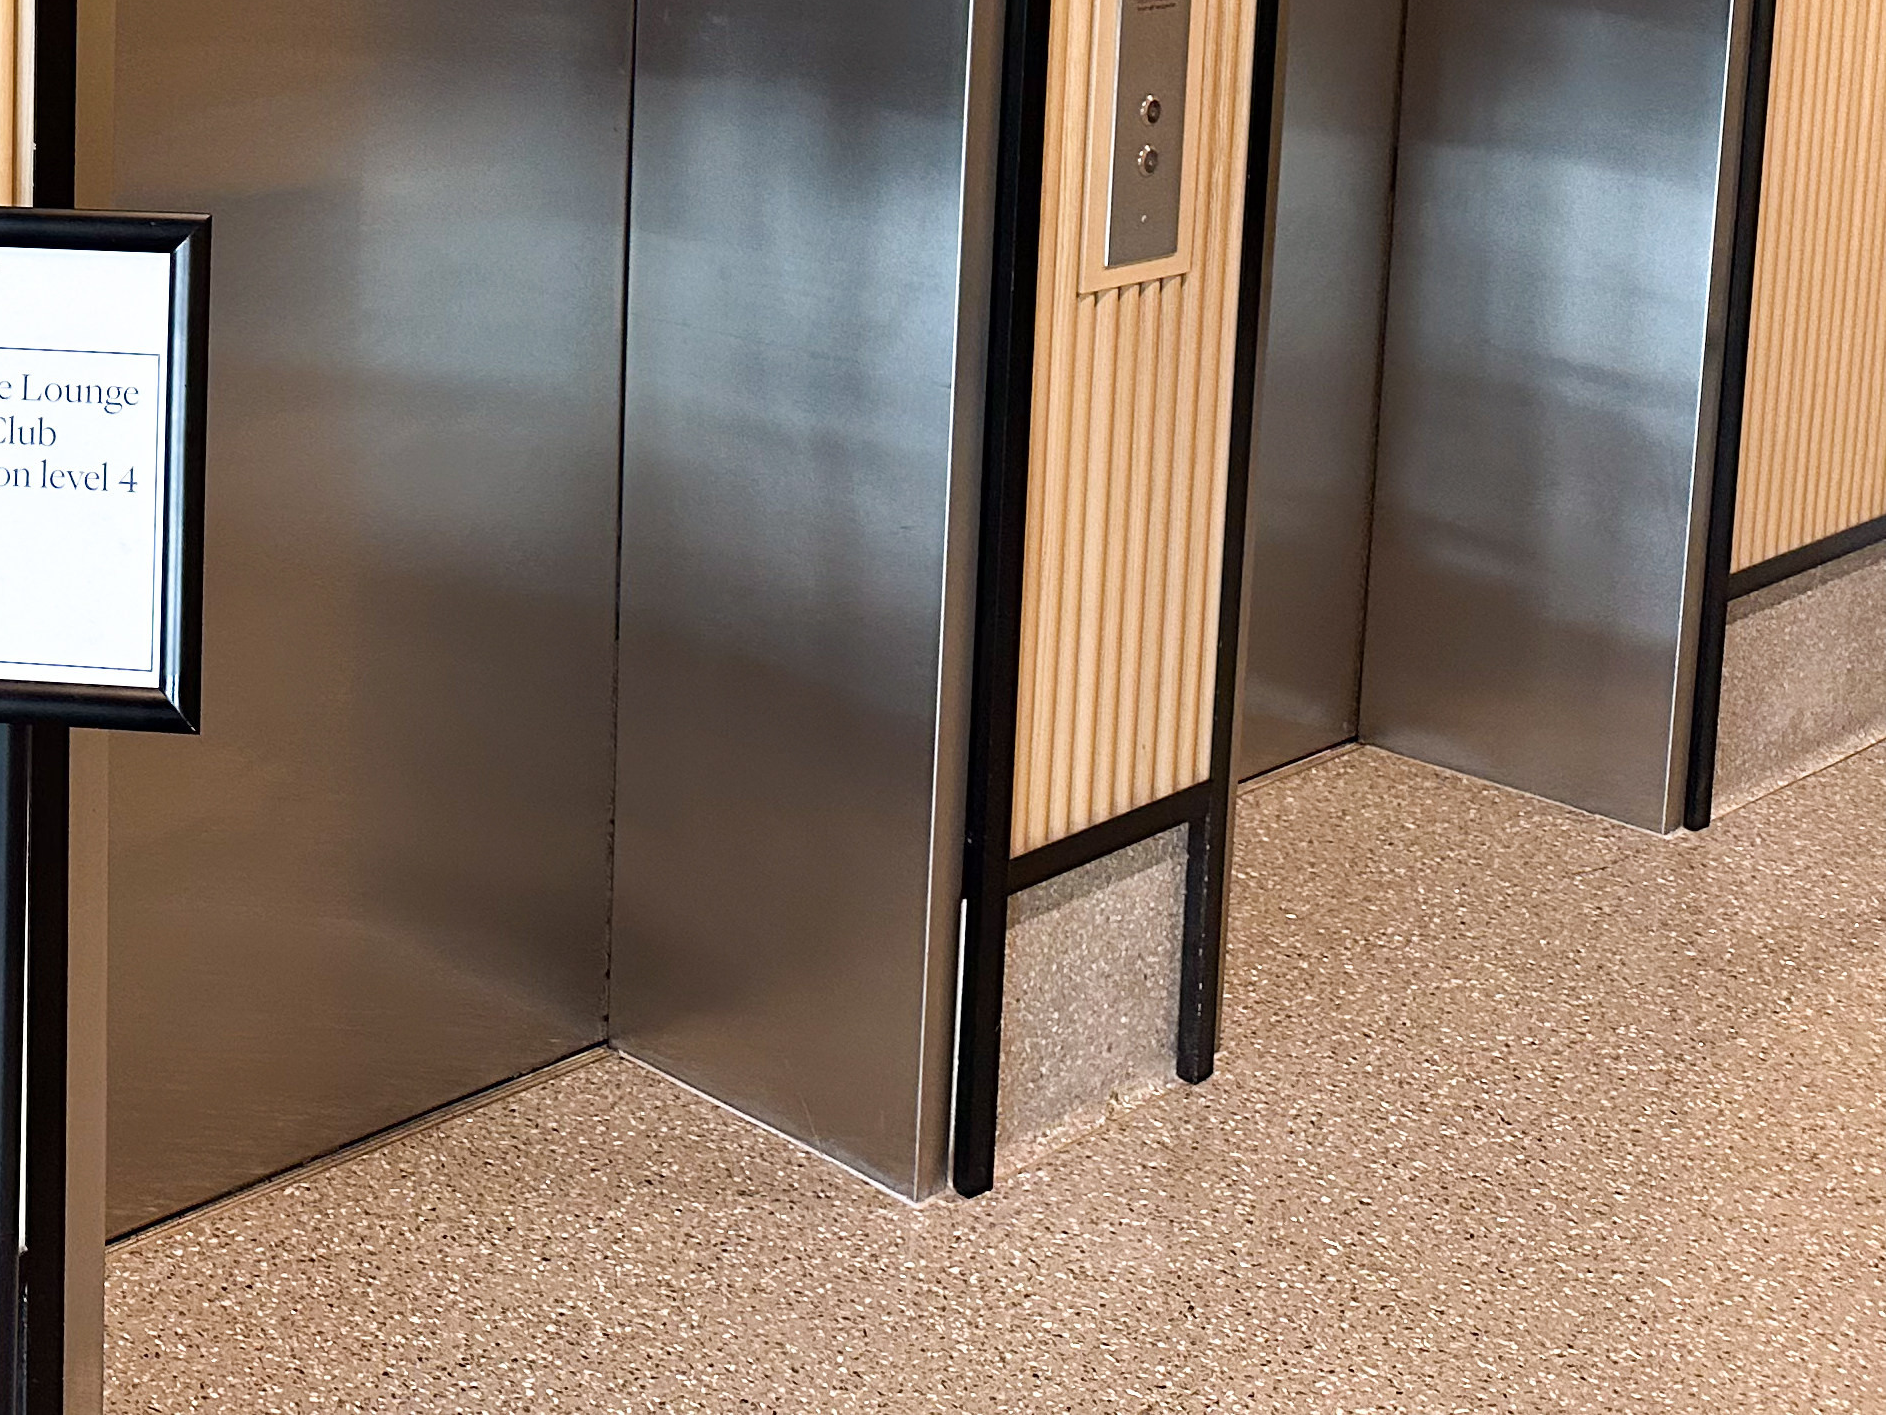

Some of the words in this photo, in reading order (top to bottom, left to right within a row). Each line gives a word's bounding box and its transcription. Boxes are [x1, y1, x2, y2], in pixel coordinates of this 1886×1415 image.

[21, 373, 140, 414] Lounge
[41, 459, 108, 492] level
[118, 466, 138, 493] 4
